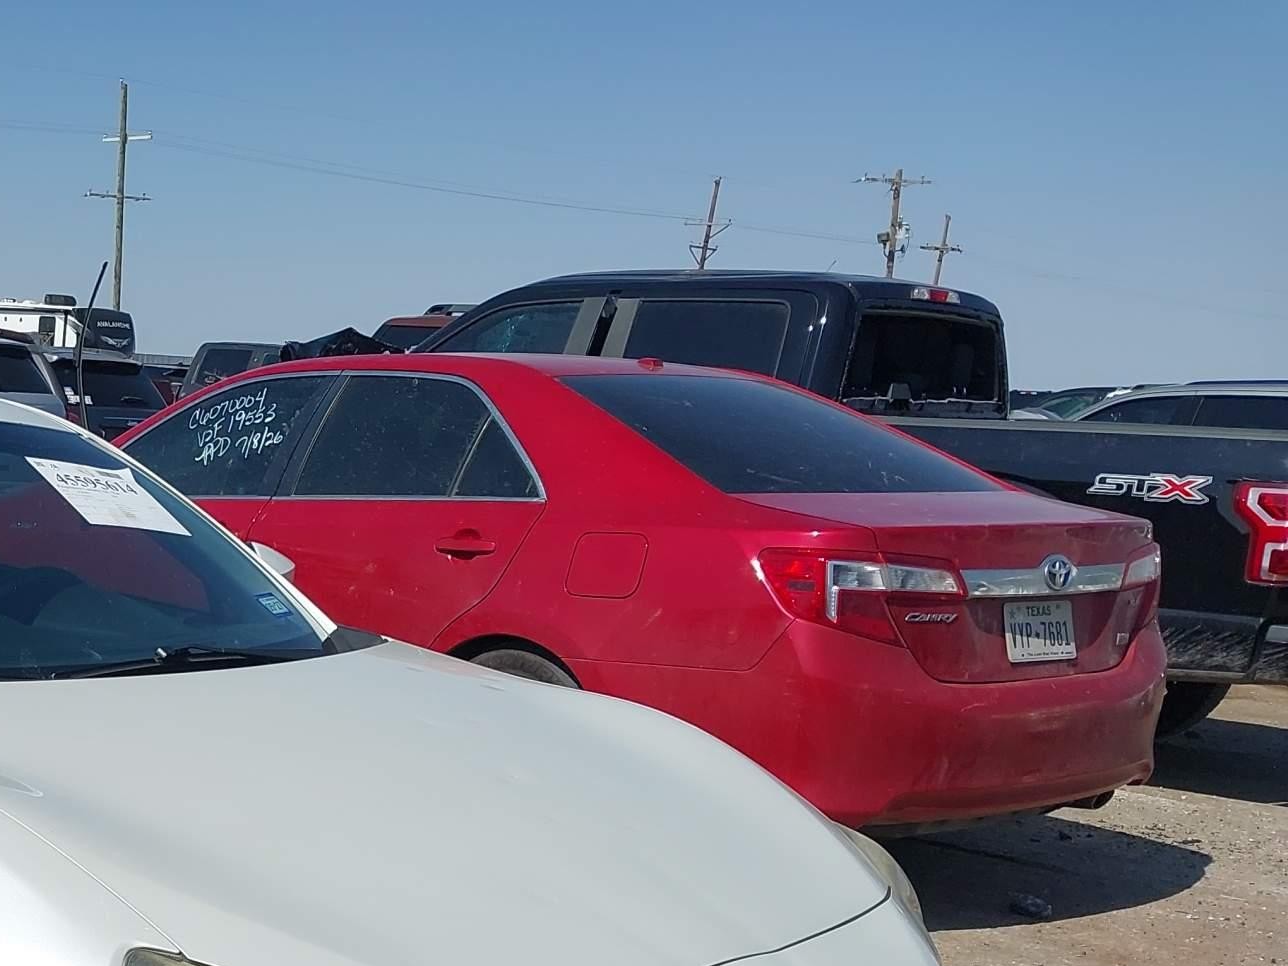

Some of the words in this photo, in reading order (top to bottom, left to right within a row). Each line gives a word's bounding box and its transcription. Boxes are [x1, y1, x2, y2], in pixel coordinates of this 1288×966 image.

[235, 426, 283, 459] 7/8/26
[56, 473, 138, 496] 45595614
[1086, 473, 1213, 505] STX
[1026, 605, 1052, 617] TEXAS
